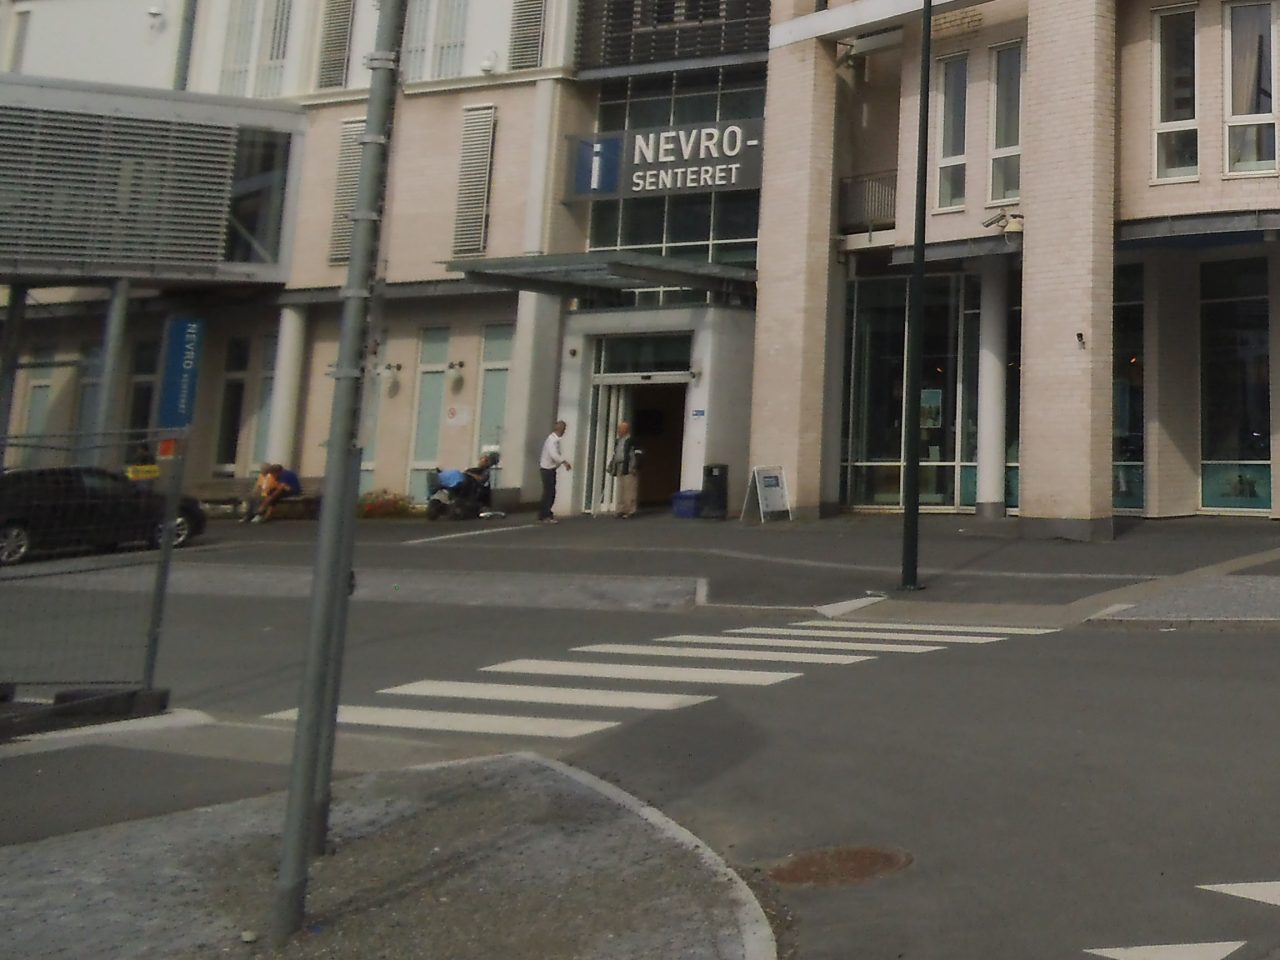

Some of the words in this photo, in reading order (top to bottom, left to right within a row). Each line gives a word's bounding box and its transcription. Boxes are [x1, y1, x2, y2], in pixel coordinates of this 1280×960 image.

[632, 125, 759, 165] NEVRO-
[631, 163, 741, 192] SENTERET
[182, 323, 198, 369] NEVRO
